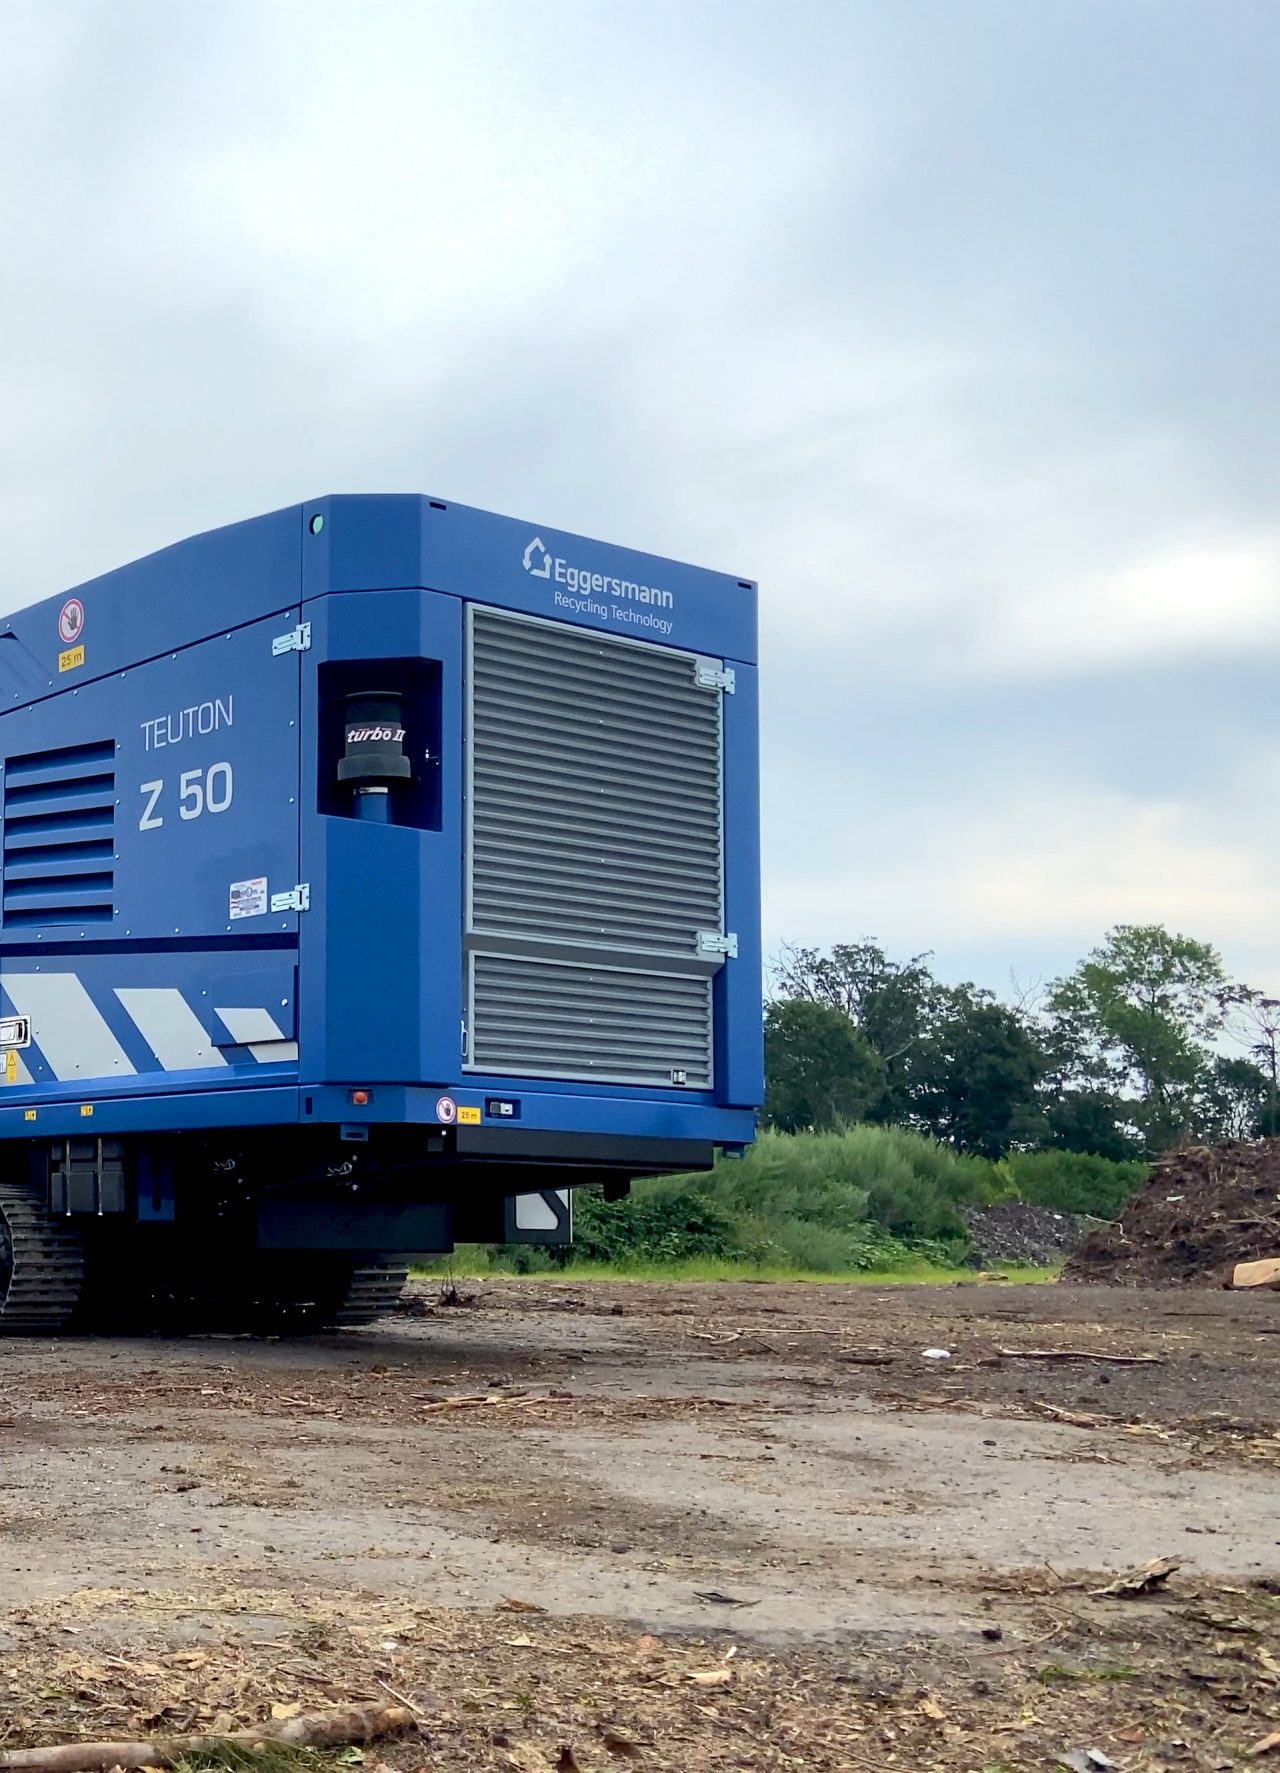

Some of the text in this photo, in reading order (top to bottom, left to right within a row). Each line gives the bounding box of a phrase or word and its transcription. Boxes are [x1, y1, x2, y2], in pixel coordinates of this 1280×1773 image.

[554, 557, 673, 609] Eggersmann
[554, 591, 673, 635] Recycling Technology
[61, 652, 82, 668] 25 m
[140, 695, 233, 751] TEUTON
[392, 729, 406, 742] II
[139, 761, 233, 832] Z 50
[461, 1111, 470, 1119] 25
